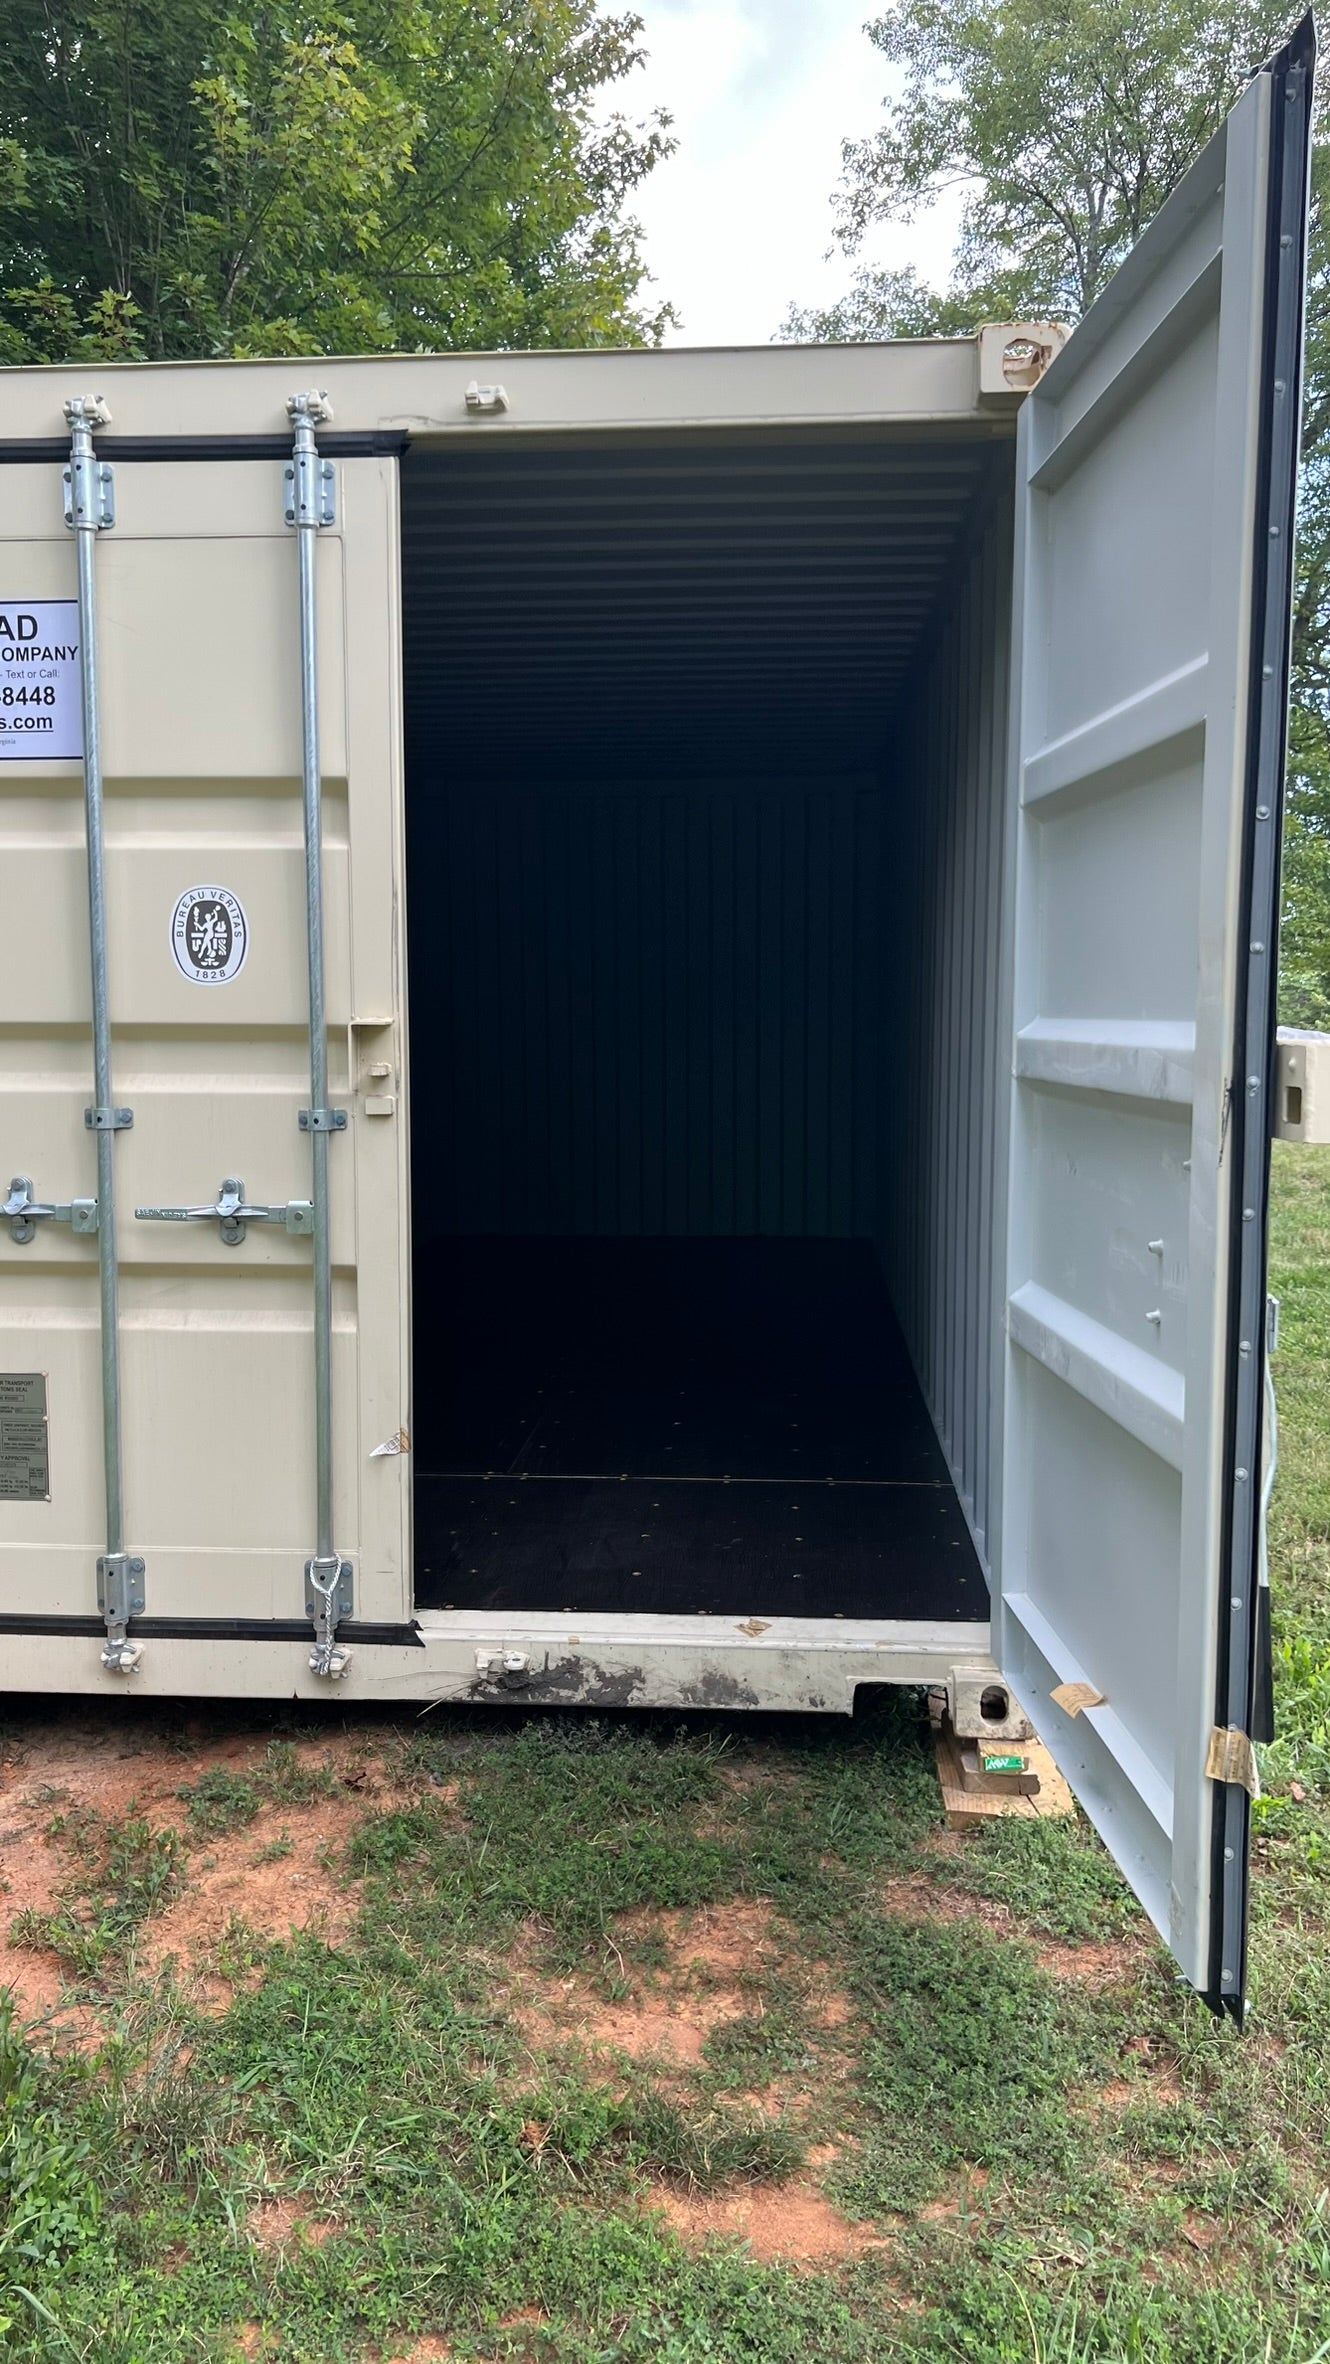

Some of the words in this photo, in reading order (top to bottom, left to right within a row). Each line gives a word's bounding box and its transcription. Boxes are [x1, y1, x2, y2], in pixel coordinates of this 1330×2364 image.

[5, 670, 25, 679] Text
[27, 671, 36, 679] or
[39, 669, 60, 679] Call:
[0, 686, 56, 706] 8448
[176, 891, 205, 938] BUREAU
[210, 891, 242, 938] VERITAS
[195, 969, 226, 979] 1828
